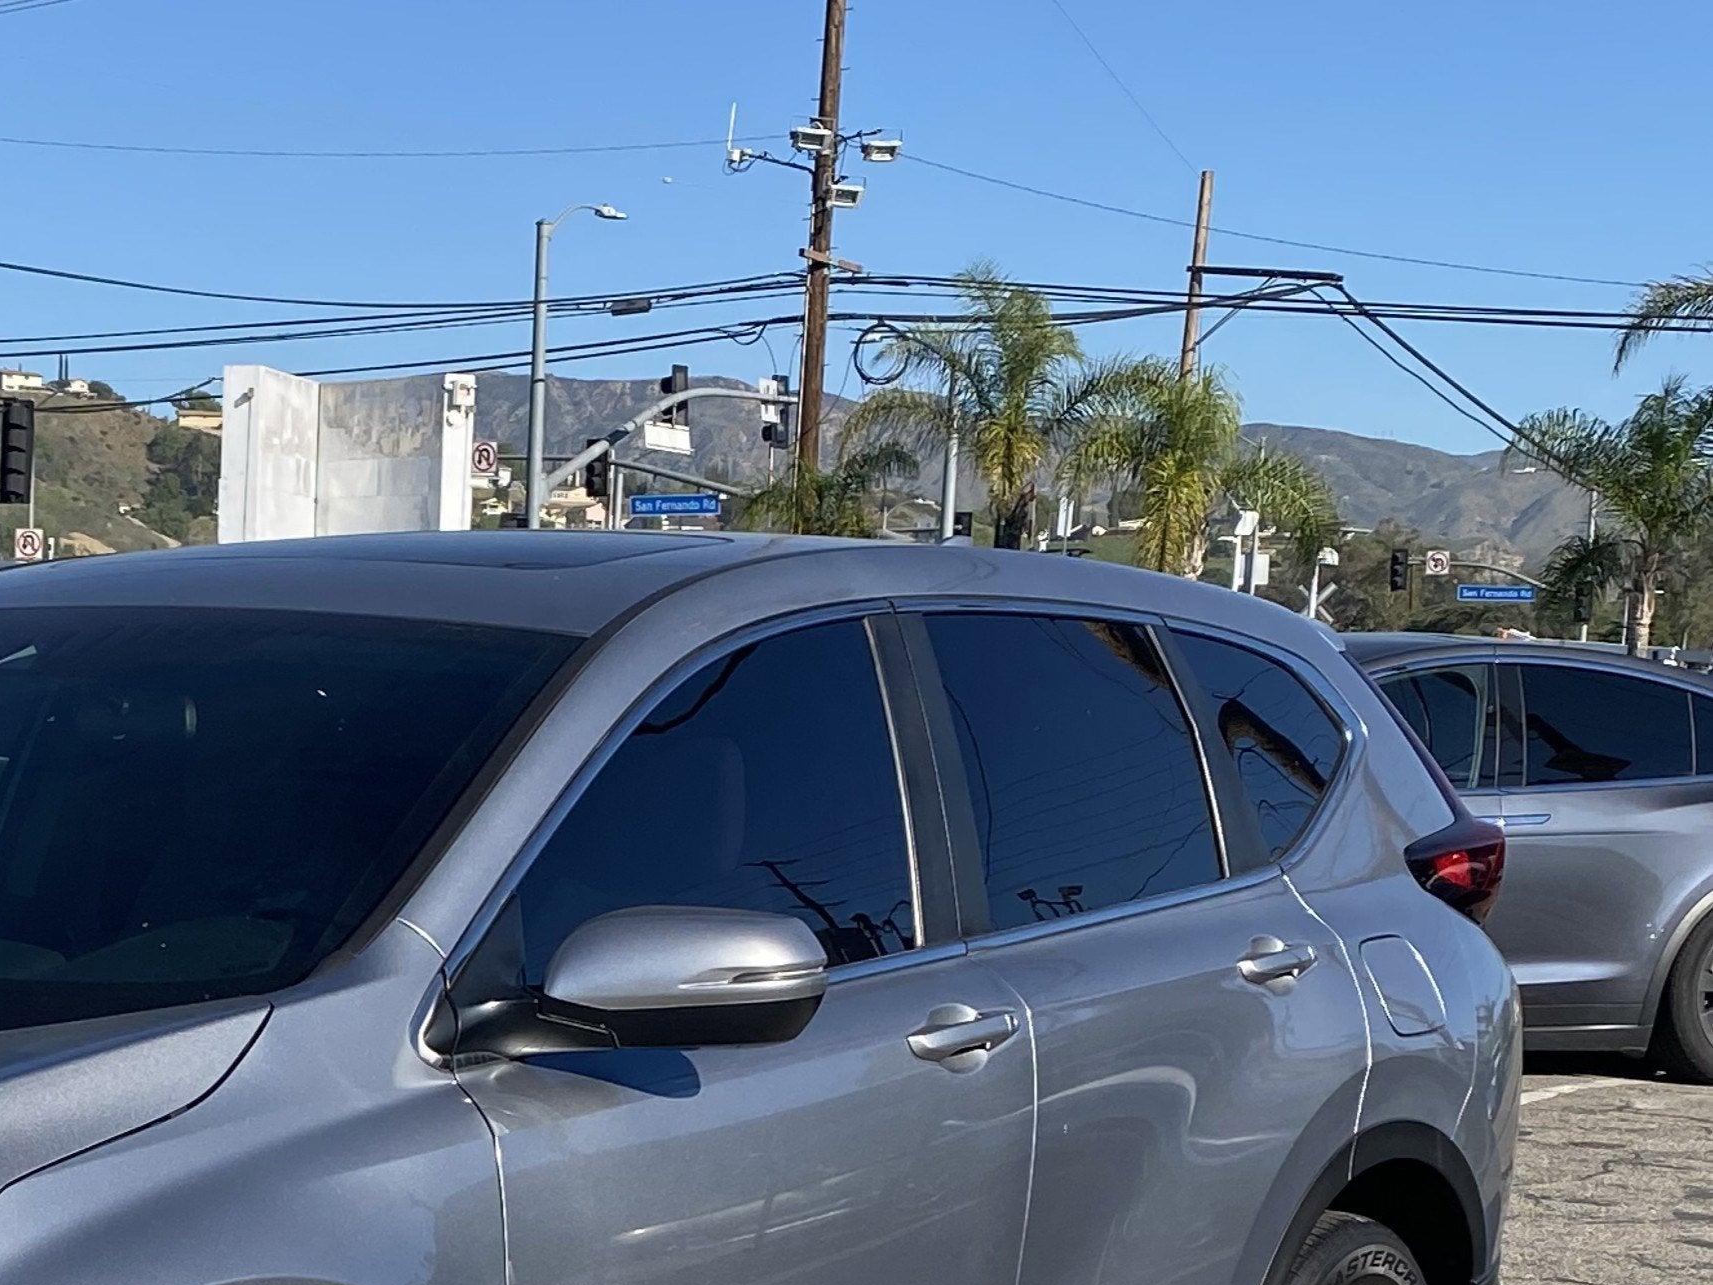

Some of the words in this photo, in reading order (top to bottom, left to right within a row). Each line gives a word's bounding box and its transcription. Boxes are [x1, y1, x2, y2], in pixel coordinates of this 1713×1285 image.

[636, 501, 653, 512] San
[655, 500, 701, 511] Fernando
[703, 499, 716, 510] Rd
[1462, 588, 1478, 597] San
[1480, 588, 1518, 598] Fernando
[1520, 588, 1532, 598] Rd
